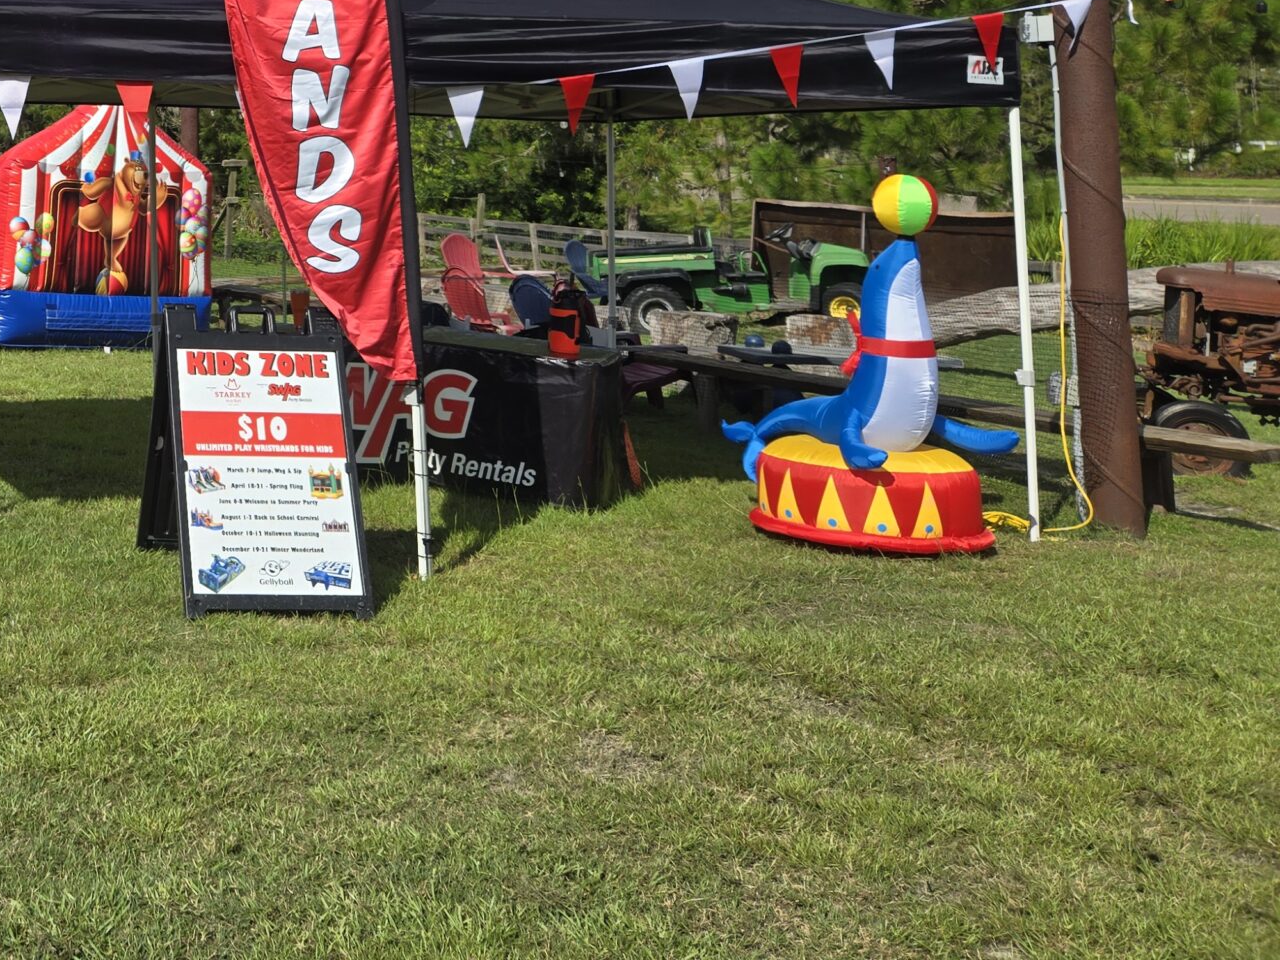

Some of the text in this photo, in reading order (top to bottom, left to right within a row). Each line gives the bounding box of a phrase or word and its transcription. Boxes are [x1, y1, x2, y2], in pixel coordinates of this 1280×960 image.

[186, 351, 330, 378] KIDS ZONE
[214, 391, 251, 399] STARKEY
[268, 383, 301, 401] SWAG
[238, 414, 287, 442] $10
[196, 443, 232, 451] UNLIMITED
[254, 444, 299, 452] WRISTBANDS
[316, 445, 334, 453] KIDS
[395, 441, 537, 487] Pty Rentals
[259, 578, 294, 587] Gellyball
